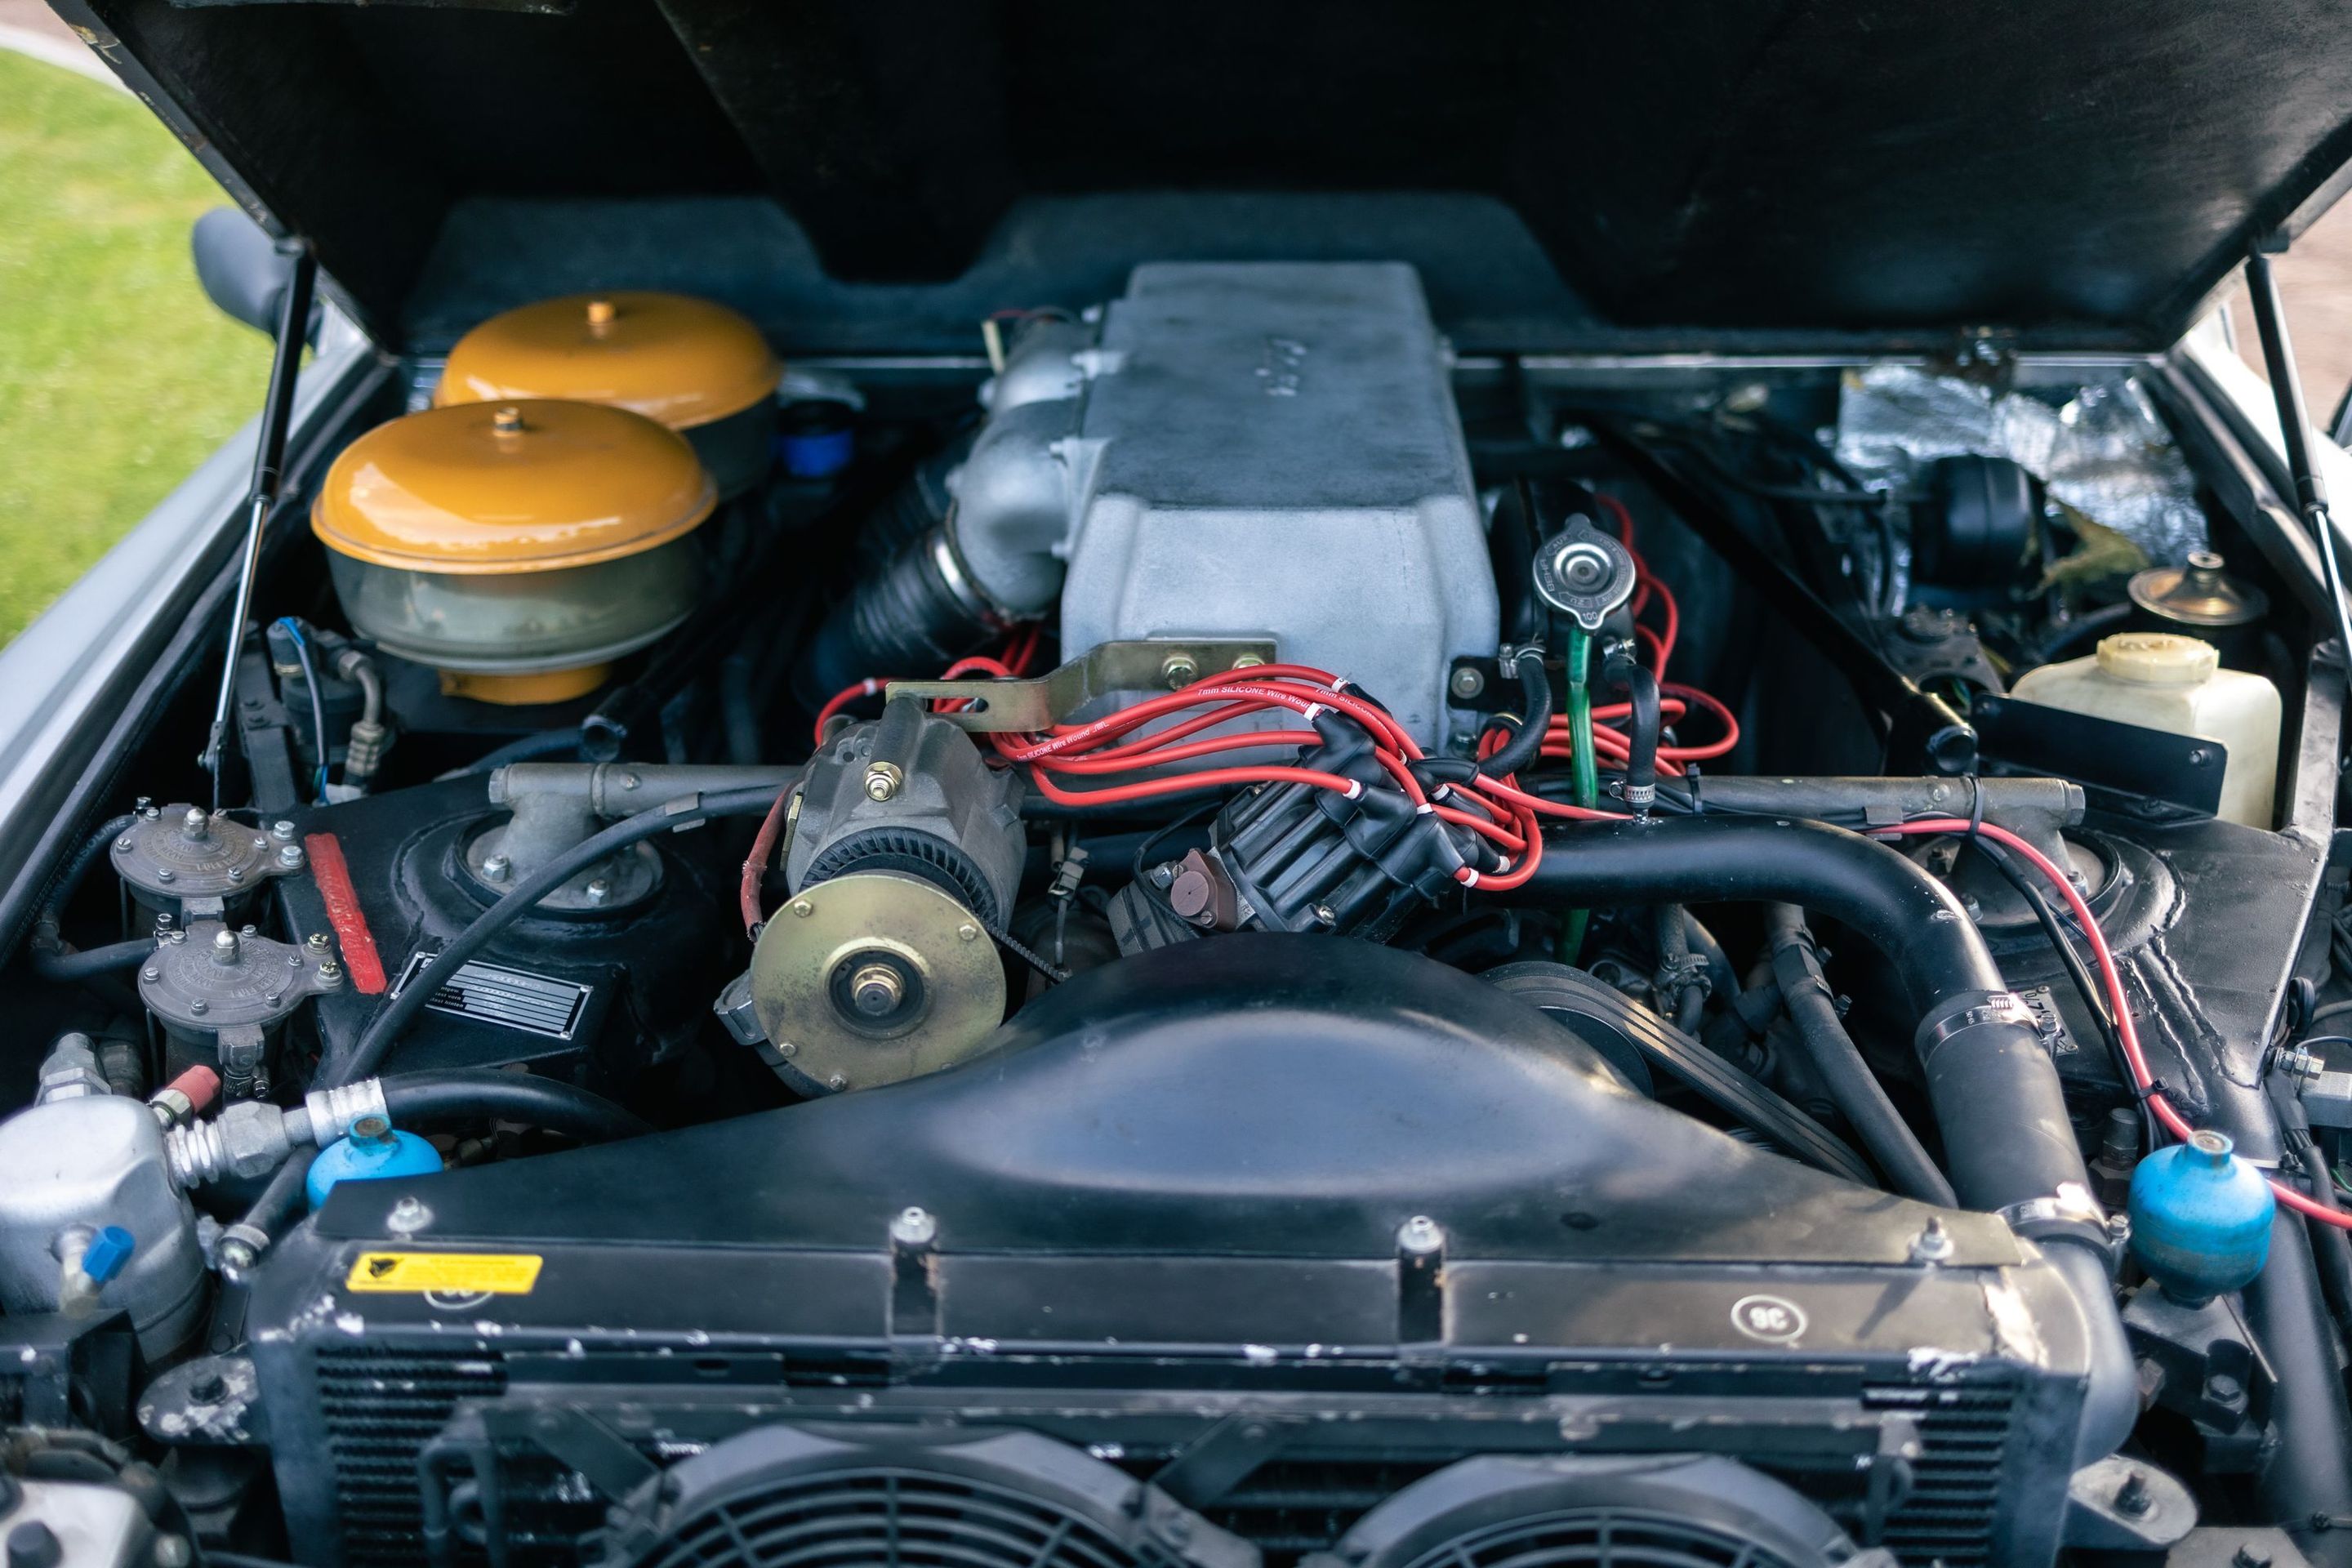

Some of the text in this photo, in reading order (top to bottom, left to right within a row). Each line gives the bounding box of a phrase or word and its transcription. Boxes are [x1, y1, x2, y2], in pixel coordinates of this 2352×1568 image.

[1539, 559, 1555, 592] BEHR
[1582, 611, 1598, 621] 100
[1197, 688, 1219, 696] 7mm
[1221, 686, 1265, 695] SILICONE
[1267, 690, 1287, 700] Wire
[1027, 746, 1052, 759] SILICONE
[1052, 741, 1067, 750] Wire
[1067, 728, 1089, 743] Wound
[69, 817, 128, 873] GASOLINE
